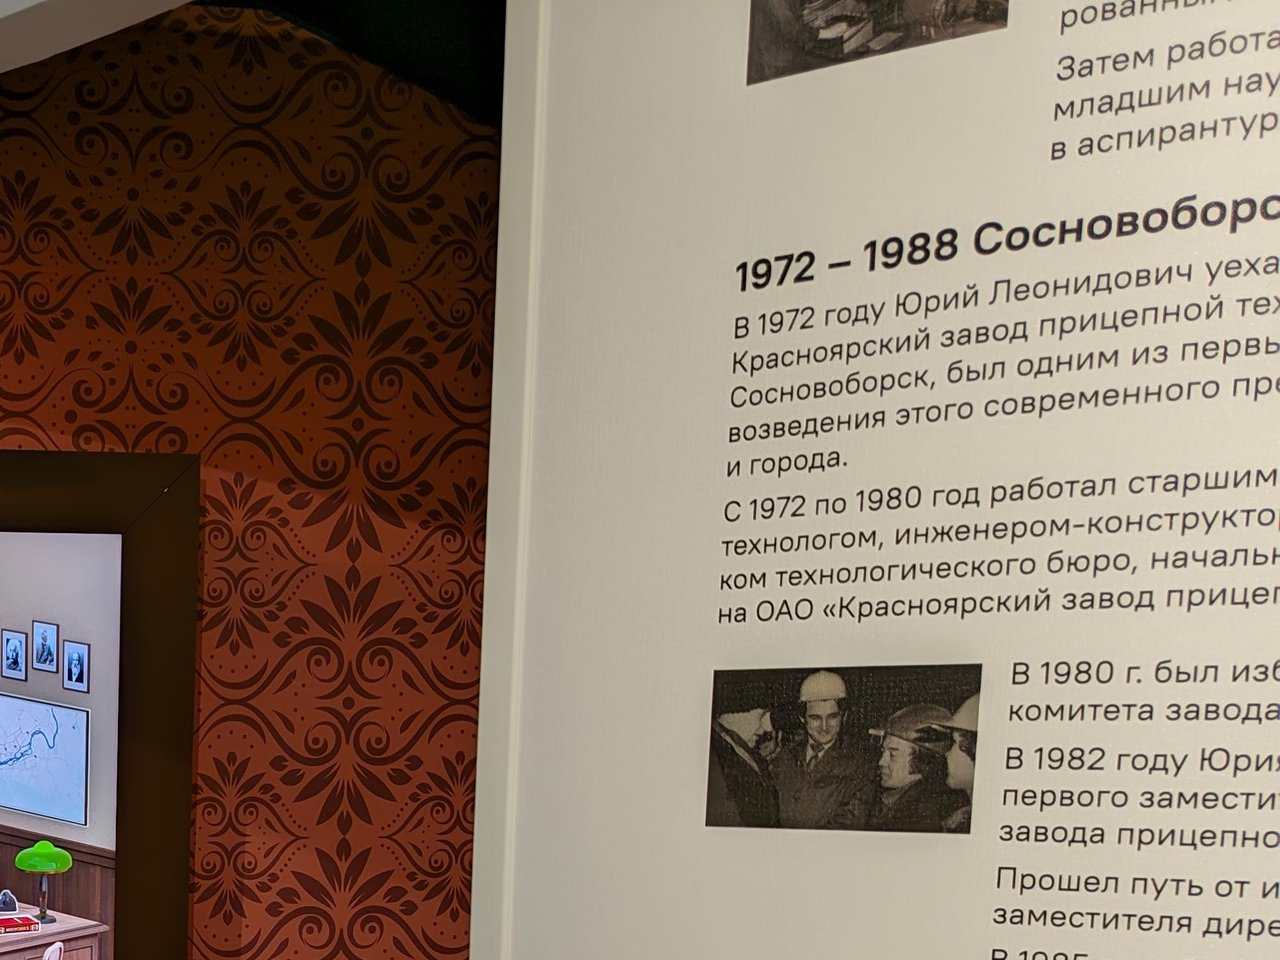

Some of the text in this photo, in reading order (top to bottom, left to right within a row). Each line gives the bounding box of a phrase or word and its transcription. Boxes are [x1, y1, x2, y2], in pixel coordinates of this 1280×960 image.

[1056, 47, 1155, 82] Затем
[1053, 79, 1211, 122] младшим
[735, 250, 816, 293] 1972
[863, 227, 959, 272] 1988
[734, 263, 1193, 340] В 1972 году Юрий Леонидович
[728, 379, 1220, 444] возведения этого современного
[726, 450, 848, 479] и города.
[723, 468, 1278, 523] С 1972 по 1980 год работал старшим
[718, 587, 1155, 625] на ОАО «Красноярский завод
[1011, 658, 1219, 686] В 1980 г. был
